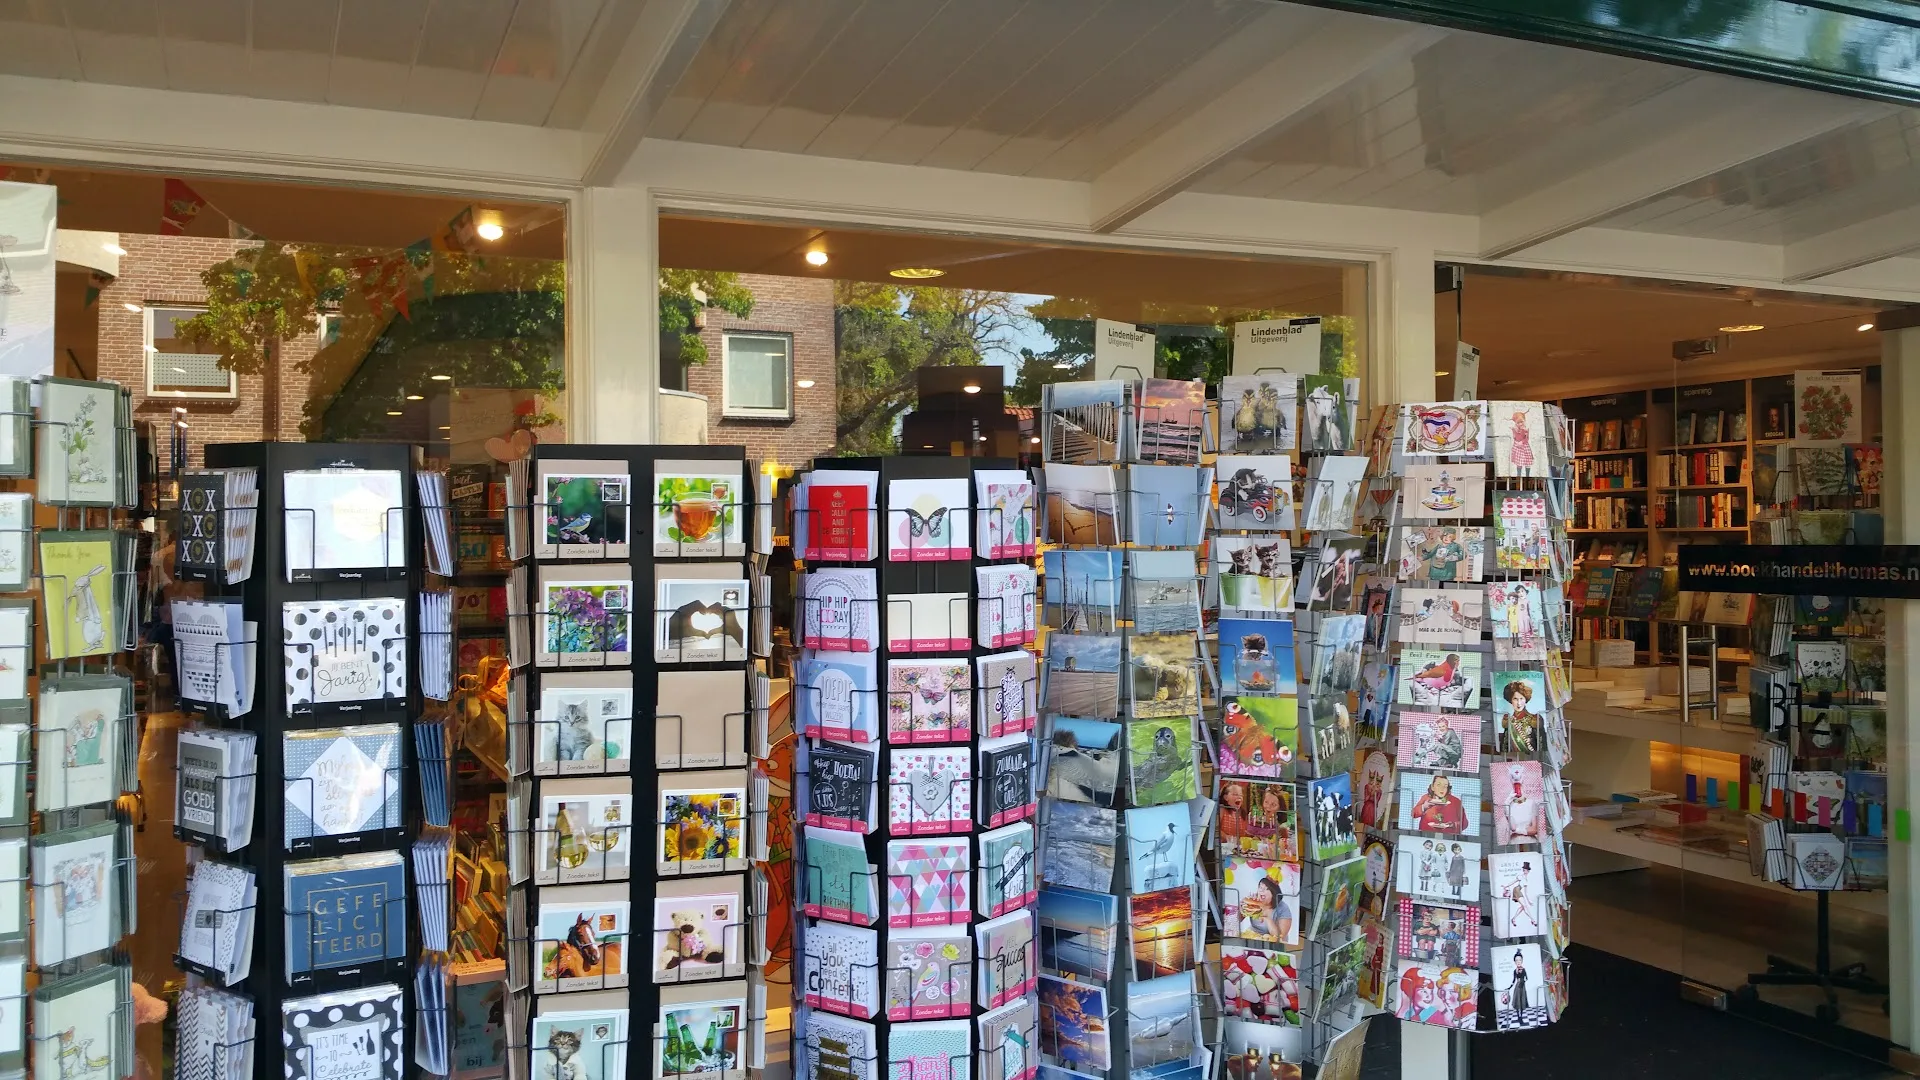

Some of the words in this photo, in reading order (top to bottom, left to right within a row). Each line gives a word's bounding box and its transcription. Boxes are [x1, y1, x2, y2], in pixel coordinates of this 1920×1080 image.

[1108, 327, 1144, 342] Lindenblad
[1251, 325, 1302, 337] Lindenblad
[1107, 337, 1134, 350] Uitgeverij
[1251, 334, 1288, 344] Uitgeverij
[1684, 388, 1712, 396] spanning
[1591, 398, 1617, 406] spanning
[820, 596, 832, 608] HIP
[835, 596, 848, 608] HIP
[341, 660, 364, 670] BENT
[183, 790, 215, 811] GOEDE
[315, 933, 382, 955] TEERD
[828, 943, 837, 954] all
[822, 949, 845, 967] you
[840, 970, 847, 981] is
[332, 1032, 348, 1046] TIME
[329, 1050, 337, 1062] TO
[466, 1054, 482, 1069] bij
[315, 1060, 373, 1079] Celebrate
